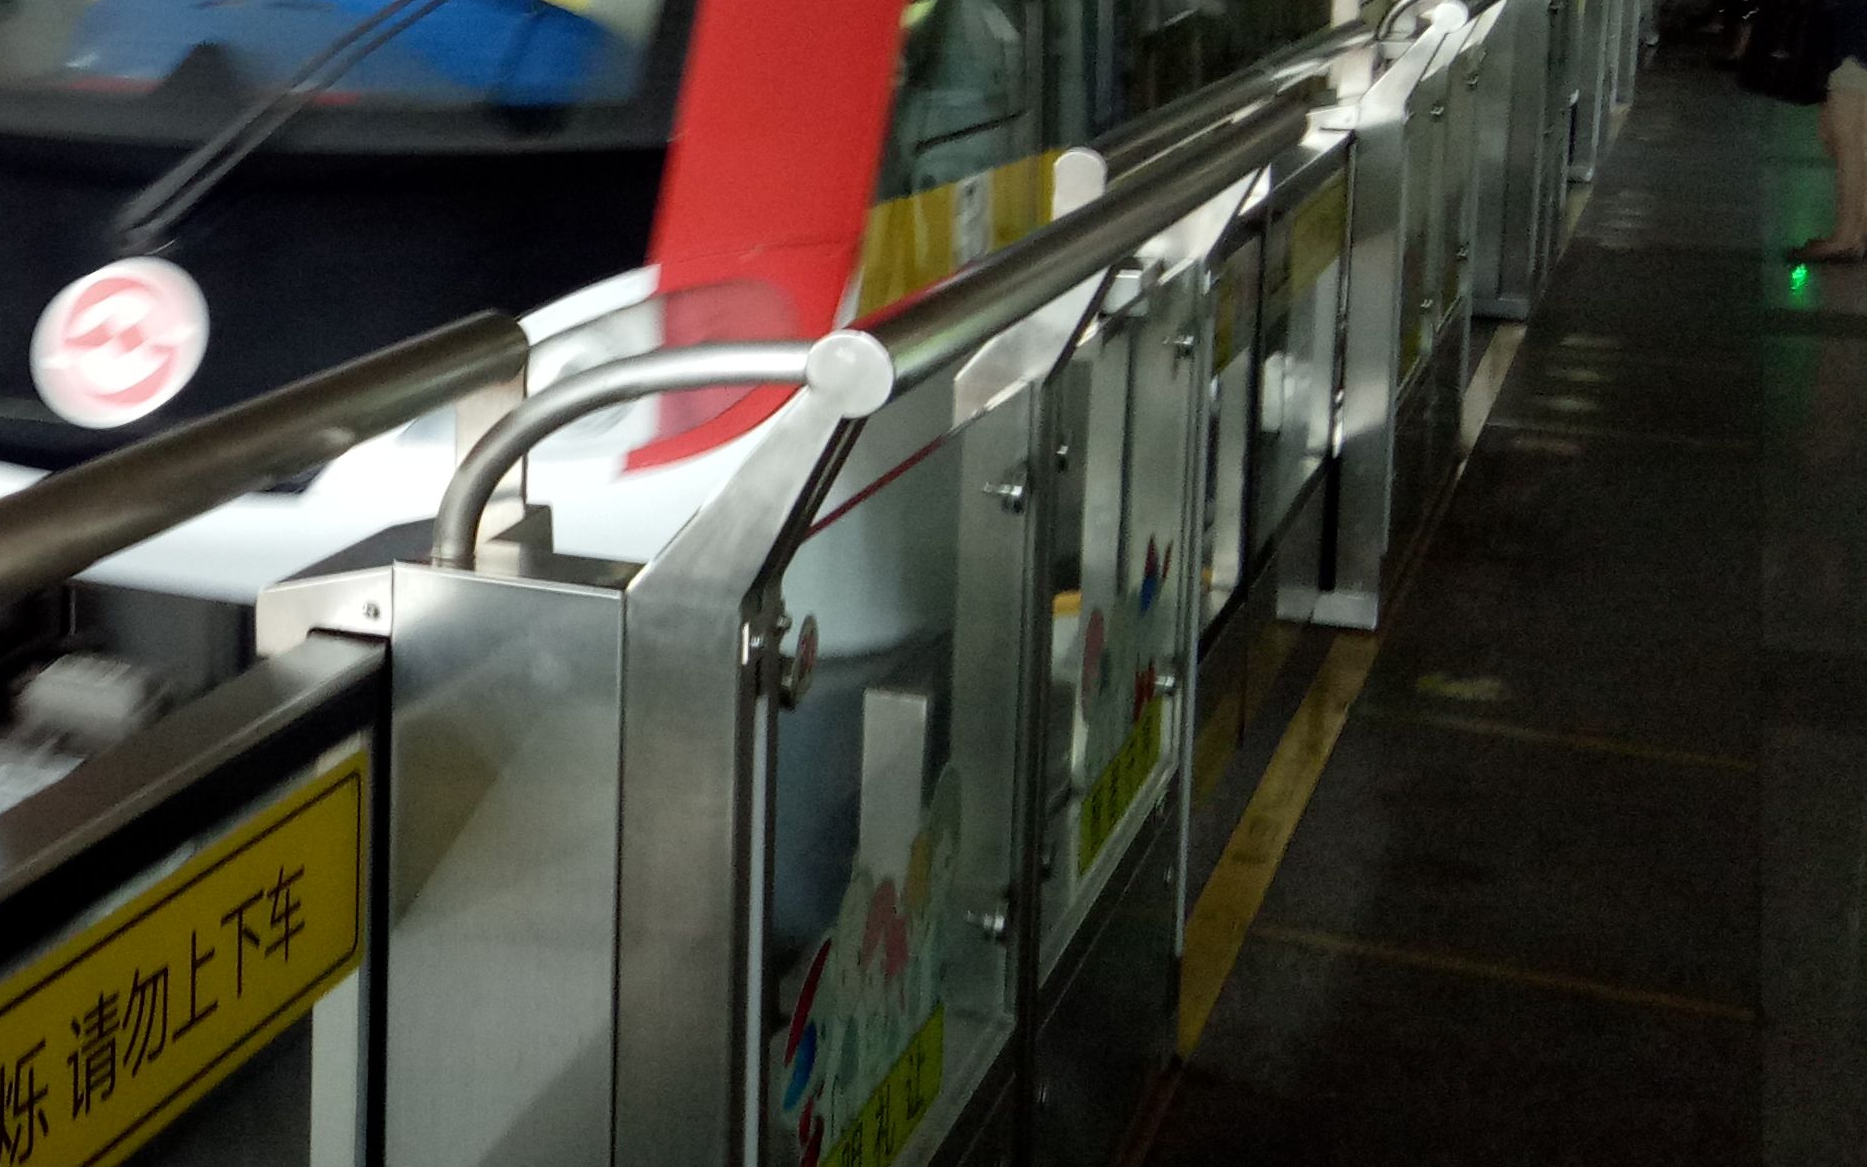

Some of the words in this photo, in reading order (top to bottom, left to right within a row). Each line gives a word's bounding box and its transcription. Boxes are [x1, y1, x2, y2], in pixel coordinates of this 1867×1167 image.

[67, 865, 305, 1121] 请勿上下车
